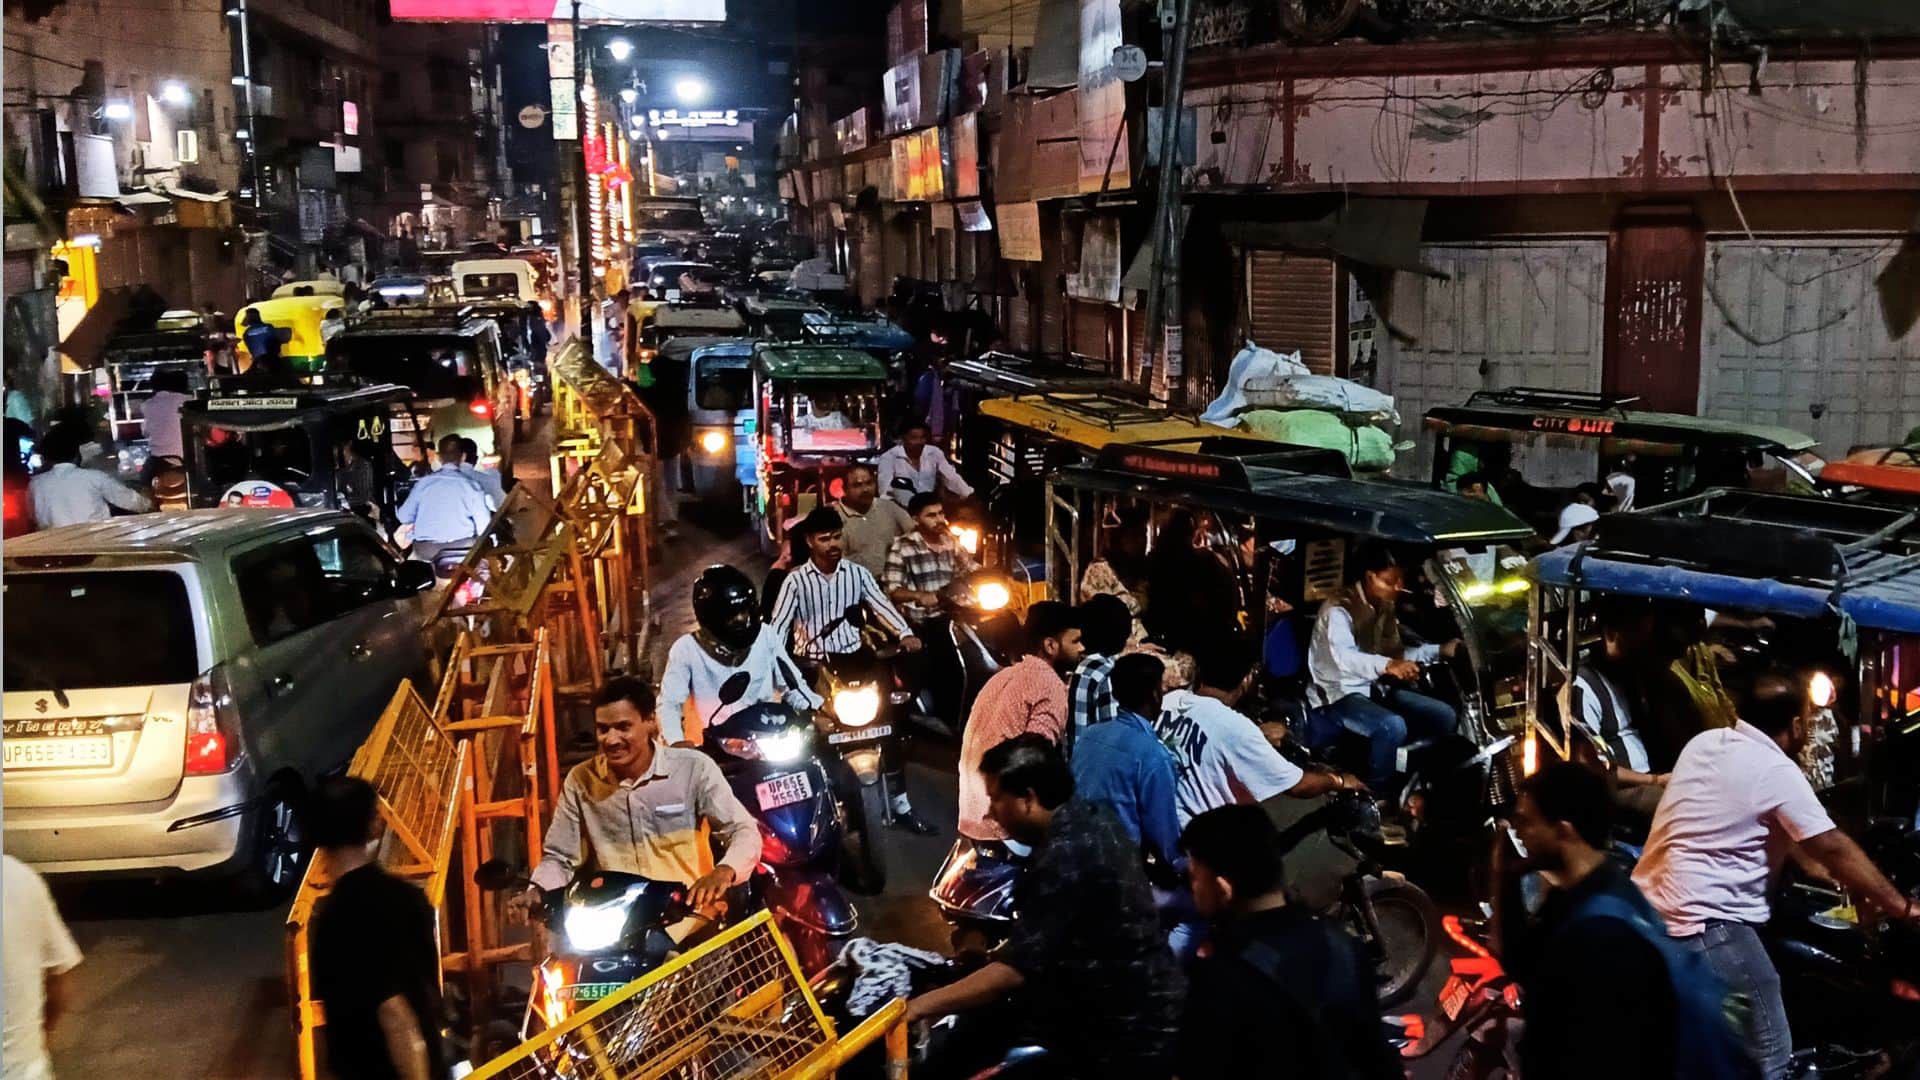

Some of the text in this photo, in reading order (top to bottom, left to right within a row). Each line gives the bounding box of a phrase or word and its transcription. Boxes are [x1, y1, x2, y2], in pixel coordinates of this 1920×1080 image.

[1533, 416, 1615, 433] CITY LIFE
[768, 775, 805, 793] UP65E
